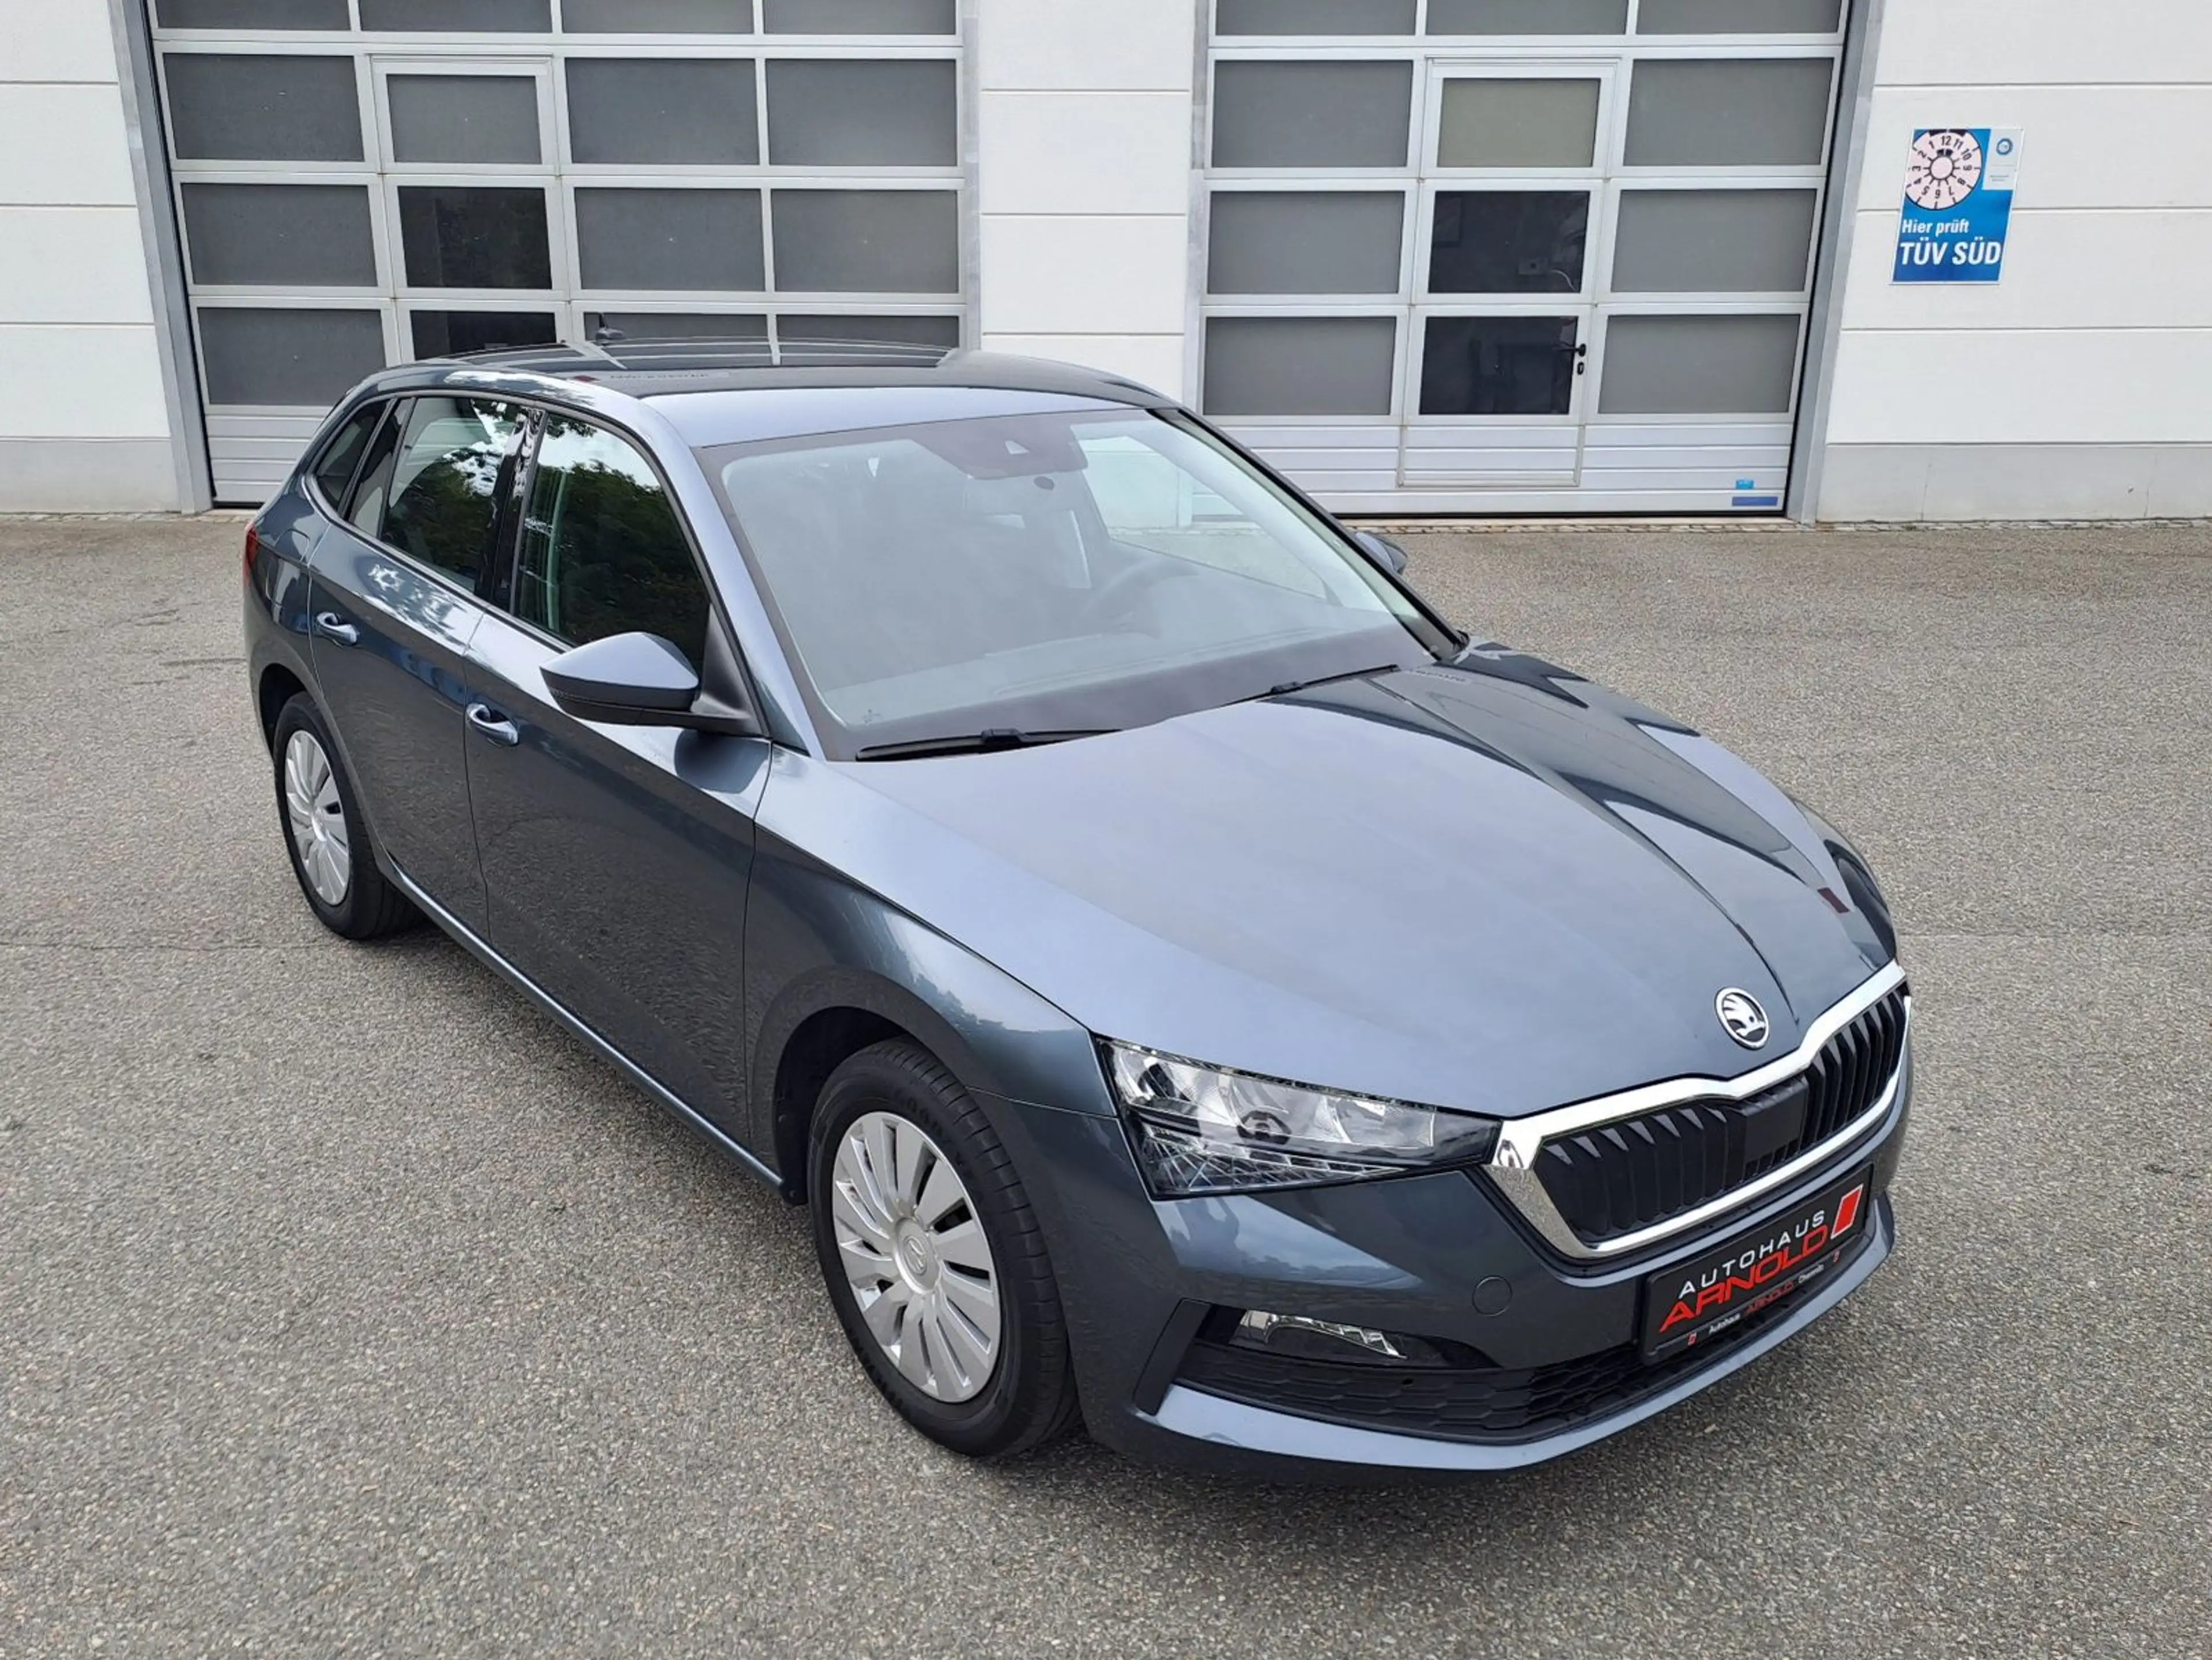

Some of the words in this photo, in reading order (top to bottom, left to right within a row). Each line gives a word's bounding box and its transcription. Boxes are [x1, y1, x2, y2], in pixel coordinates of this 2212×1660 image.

[1928, 140, 1935, 149] 1
[1940, 135, 1951, 146] 12
[1917, 150, 1927, 159] 2
[1902, 218, 1933, 233] Hier
[1935, 218, 1970, 237] prüft
[1900, 236, 1949, 266] TÜV
[1951, 236, 2002, 266] SÜD
[1678, 1210, 1825, 1300] AUTOHAUS
[1659, 1224, 1828, 1333] ARNOLD
